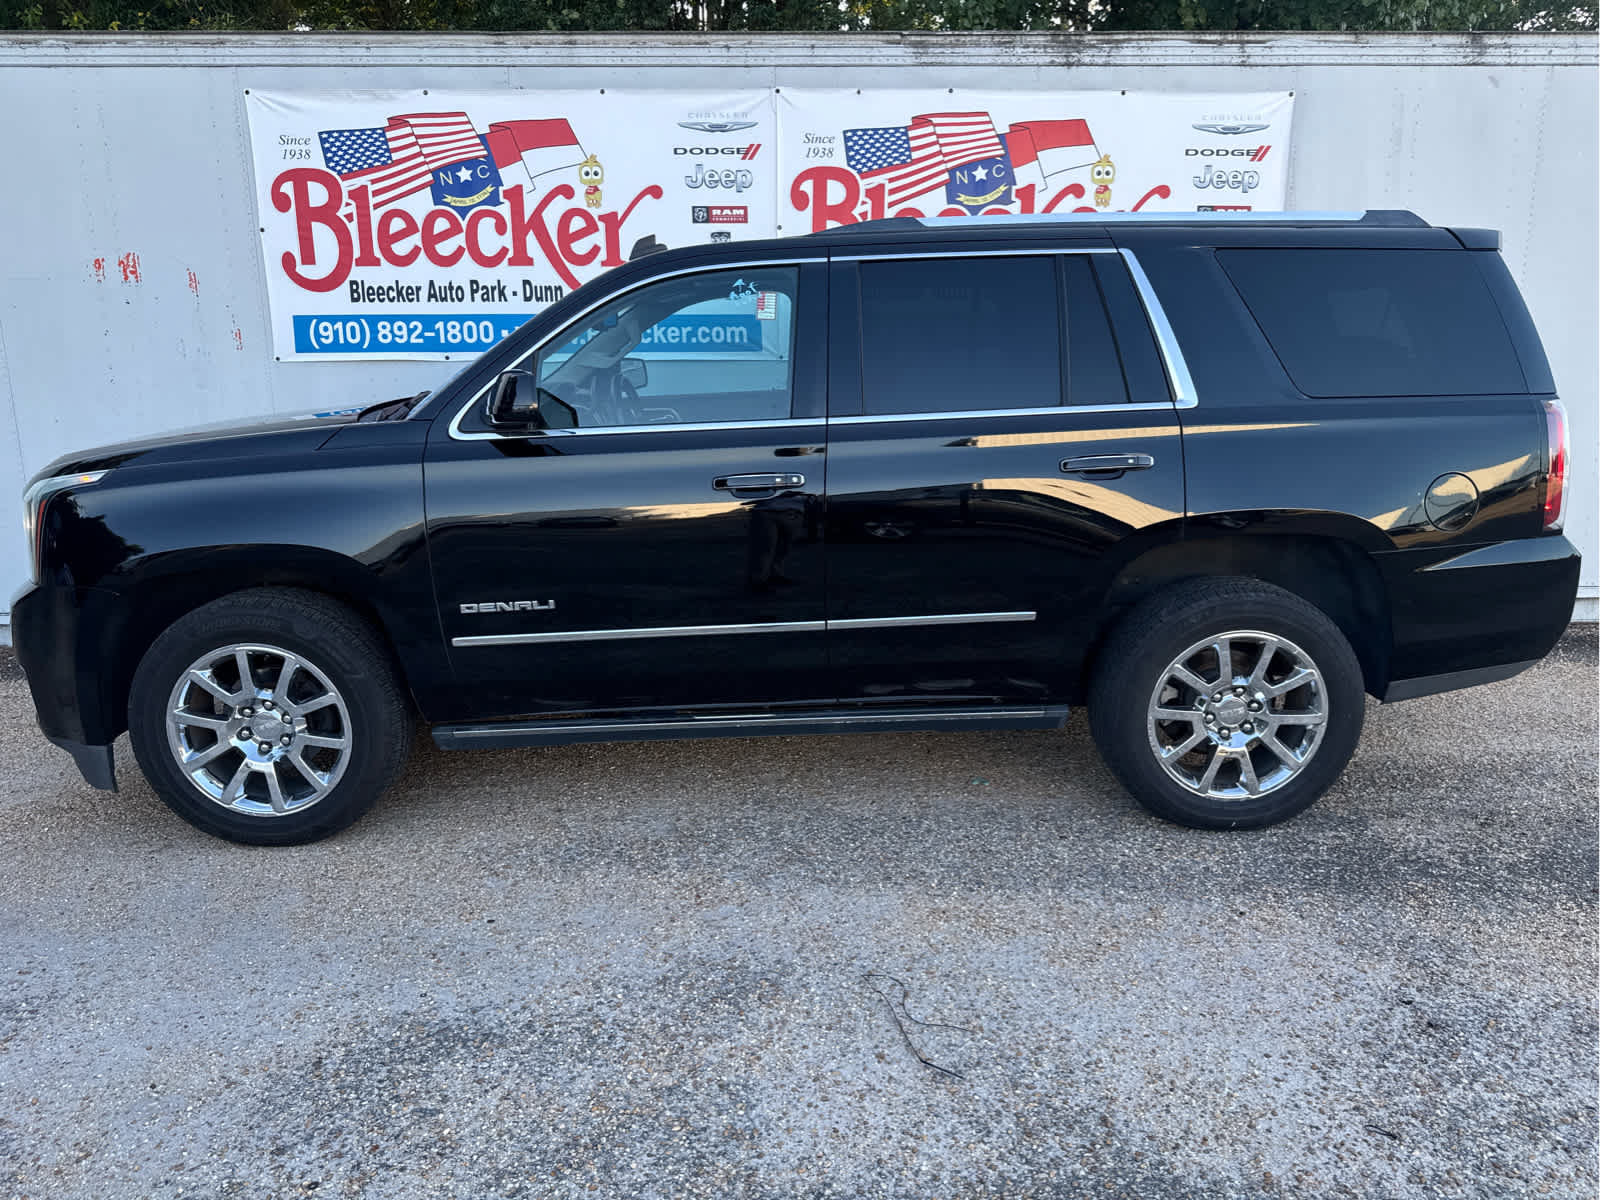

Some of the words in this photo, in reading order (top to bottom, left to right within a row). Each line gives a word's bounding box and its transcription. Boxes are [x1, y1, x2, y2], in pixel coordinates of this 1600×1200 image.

[278, 134, 312, 146] Since
[803, 132, 836, 145] Since
[281, 148, 312, 160] 1938
[673, 146, 753, 157] DODGE
[805, 147, 834, 159] 1938
[1185, 148, 1261, 158] DODGE
[439, 170, 453, 186] N
[477, 165, 490, 179] C
[684, 164, 753, 193] Jeep
[955, 169, 968, 185] N
[992, 164, 1005, 178] C
[1192, 164, 1261, 193] Jeep
[711, 208, 745, 216] RAM
[271, 167, 664, 293] Bleecker
[349, 279, 422, 303] Bleecker
[427, 279, 465, 303] Auto
[469, 279, 508, 303] Park
[522, 279, 564, 303] Dunn
[308, 318, 371, 350] (910)
[377, 320, 495, 344] 892-1800
[460, 599, 556, 614] DENALI
